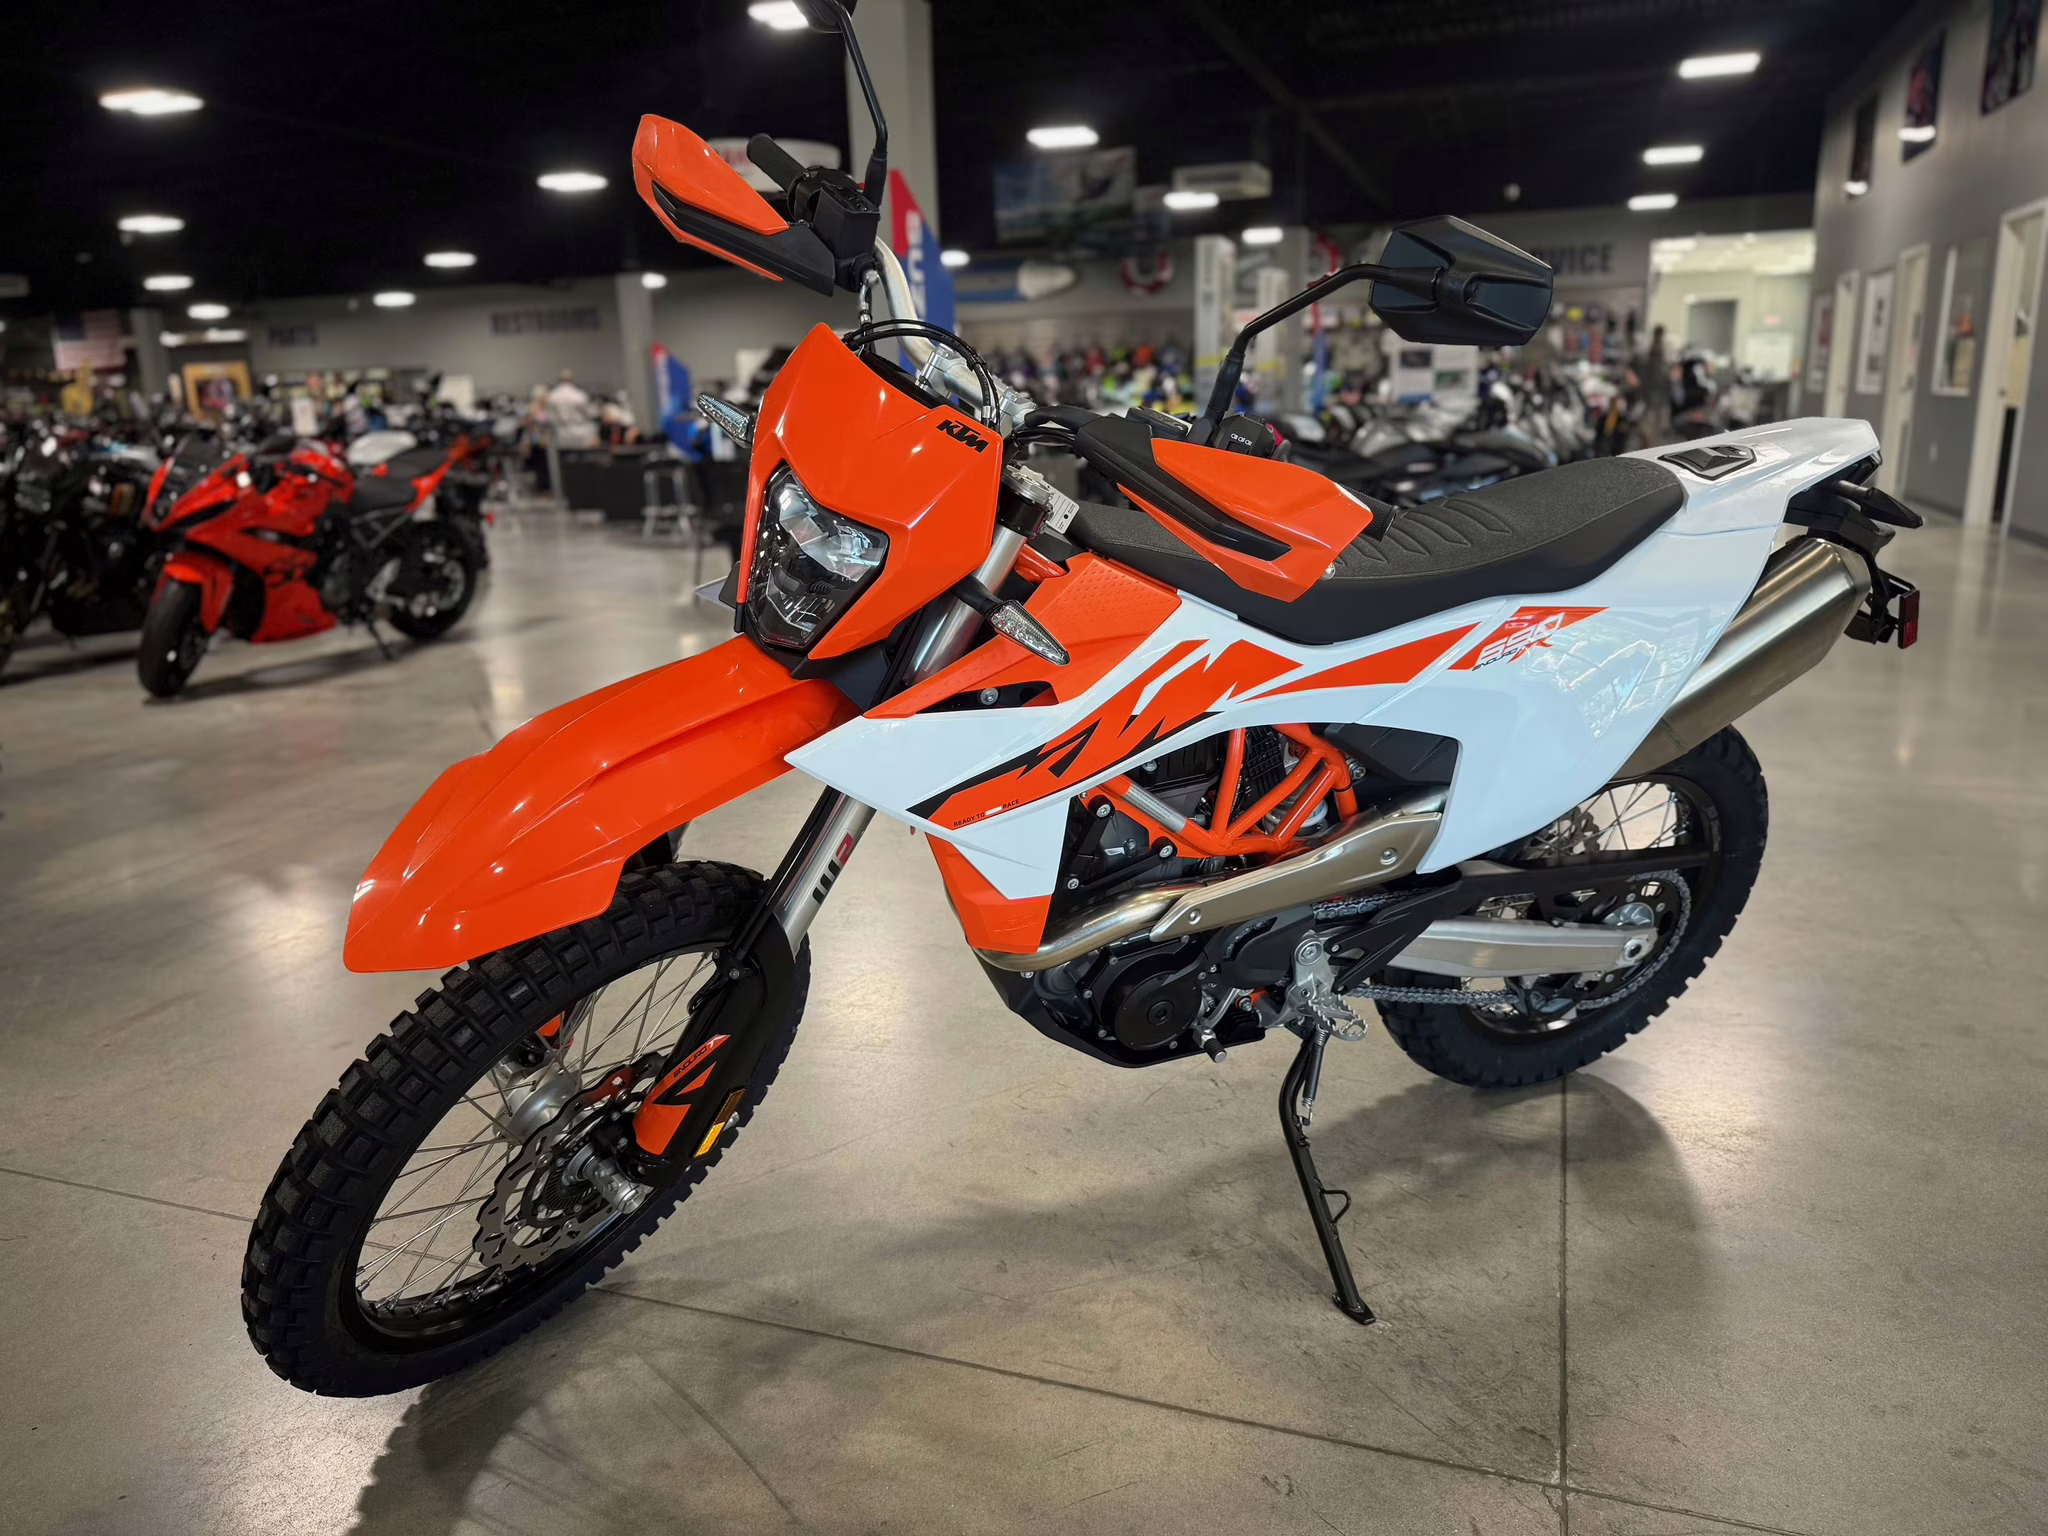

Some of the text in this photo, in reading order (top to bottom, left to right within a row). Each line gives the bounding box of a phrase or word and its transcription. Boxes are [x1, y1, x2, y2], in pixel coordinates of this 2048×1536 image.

[936, 419, 989, 453] KTM
[1472, 647, 1519, 672] ENDURO
[953, 799, 1020, 827] READY TO RACE
[673, 1045, 708, 1078] ENDURO
